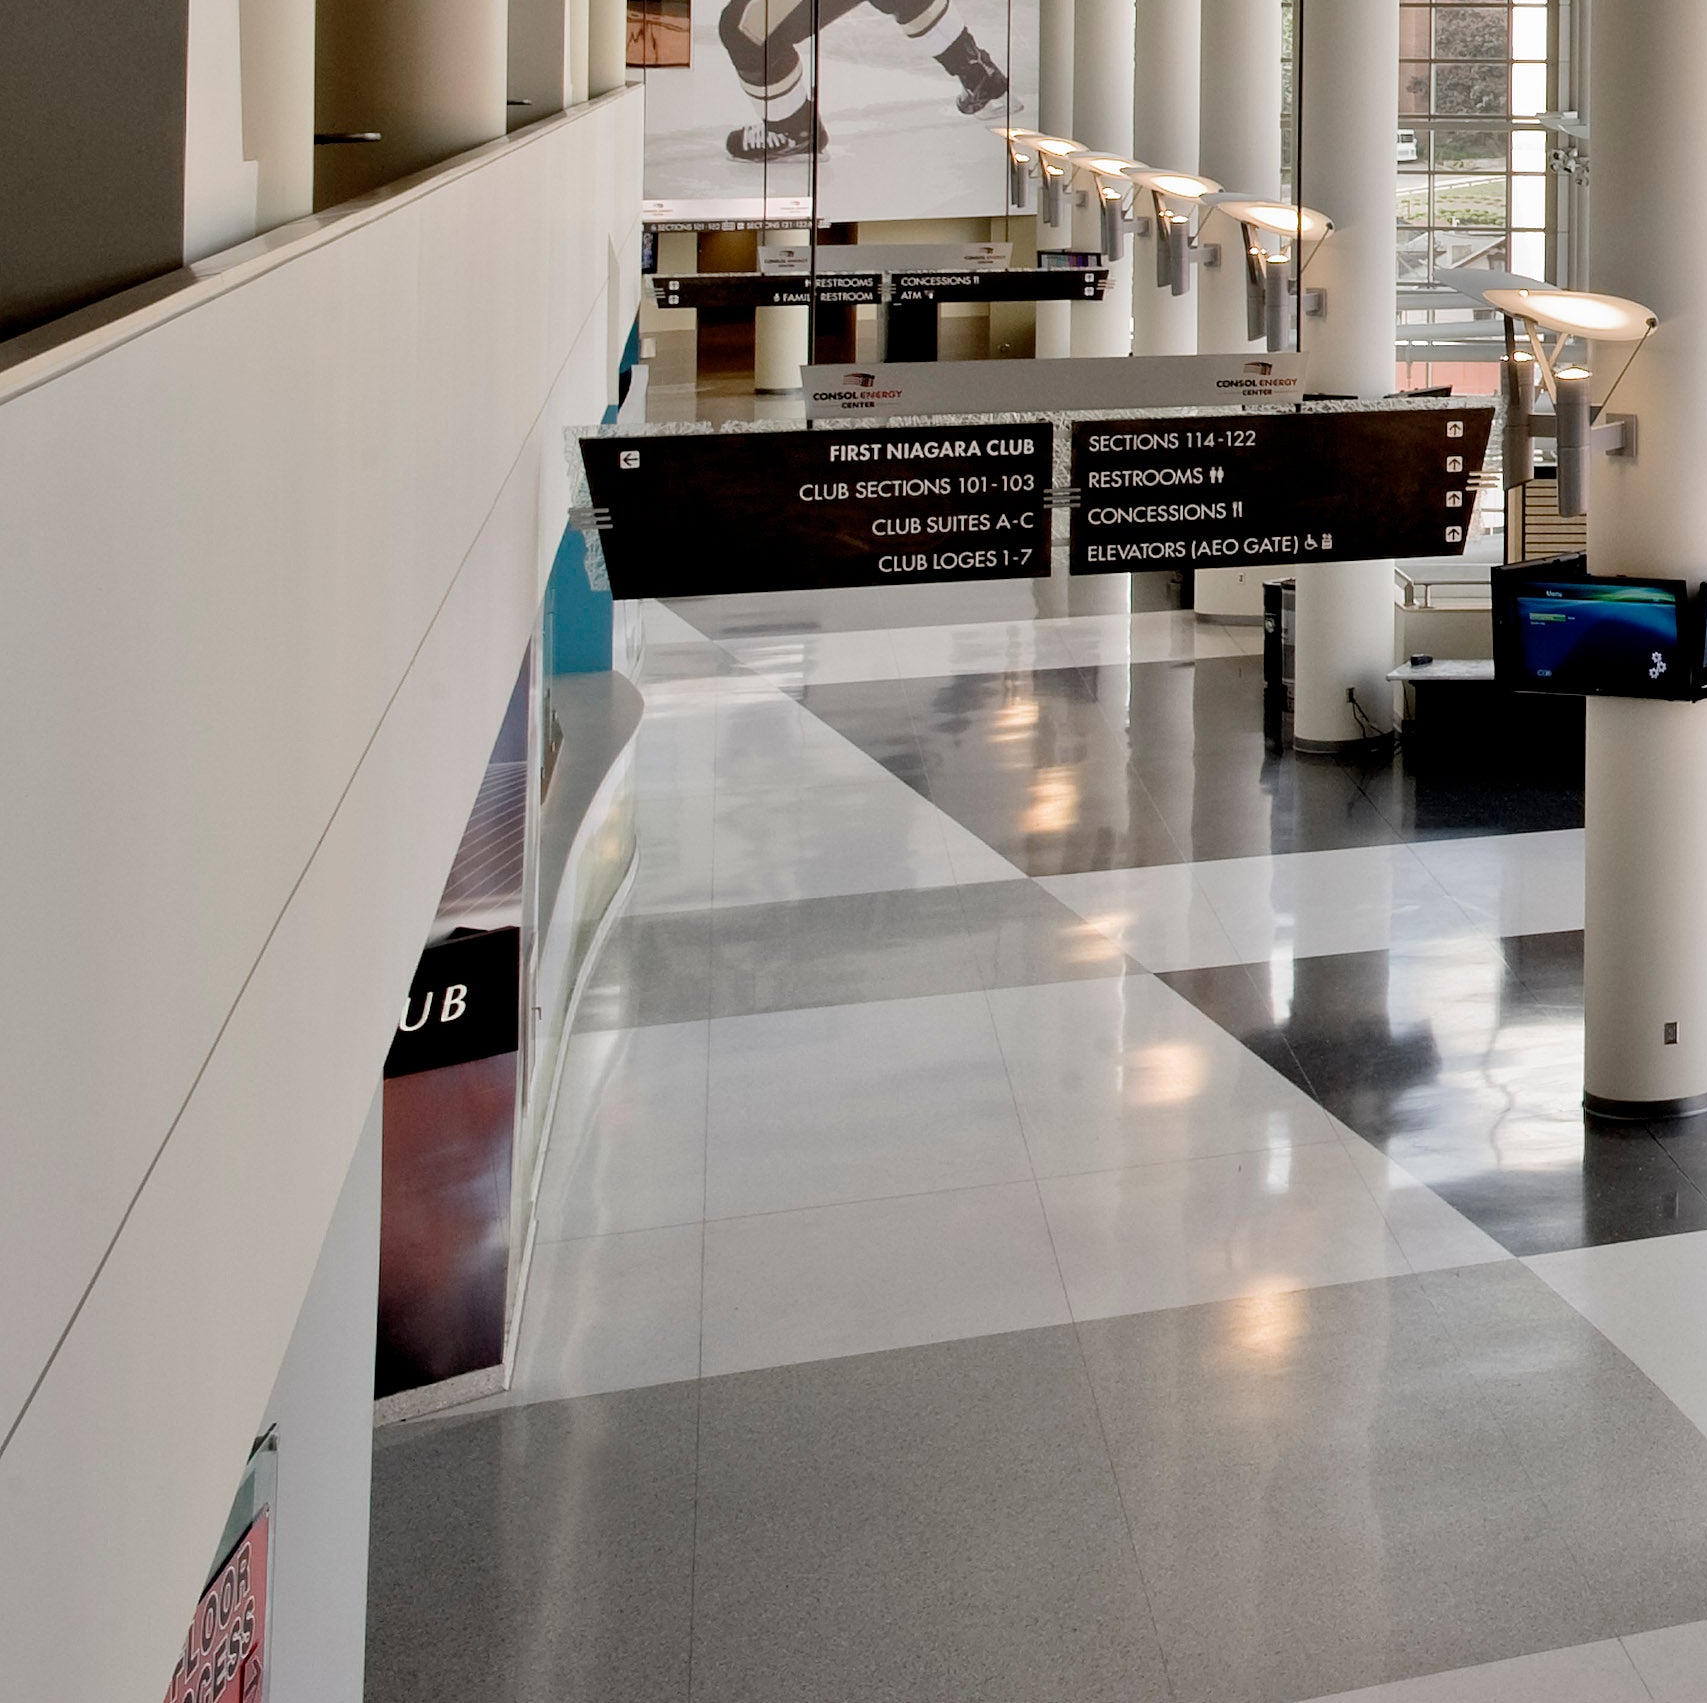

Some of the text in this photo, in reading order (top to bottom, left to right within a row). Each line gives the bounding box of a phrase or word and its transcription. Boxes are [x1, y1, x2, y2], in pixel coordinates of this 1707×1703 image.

[817, 278, 874, 288] RESTROOMS
[901, 276, 972, 287] CONCESSIONS
[783, 292, 873, 302] FAMIL RESTROOM
[901, 291, 922, 300] ATM
[1216, 378, 1297, 388] CONSOL ENERGY
[813, 390, 903, 401] CONSOL ENERGY
[1242, 388, 1272, 396] CENTER
[841, 401, 875, 409] CENTER
[1089, 430, 1256, 452] SECTIONS 114-122
[830, 439, 1035, 462] FIRST NIAGARA CLUB
[1089, 467, 1203, 488] RESTROOMS
[799, 474, 1034, 502] CLUB SECTIONS 101-103
[1088, 502, 1226, 525] CONCESSIONS
[872, 512, 1034, 536] CLUB SUITES A-C
[1087, 535, 1299, 562] ELEVATORS (AEO GATE)
[878, 549, 1033, 573] CLUB LOGES 1-7
